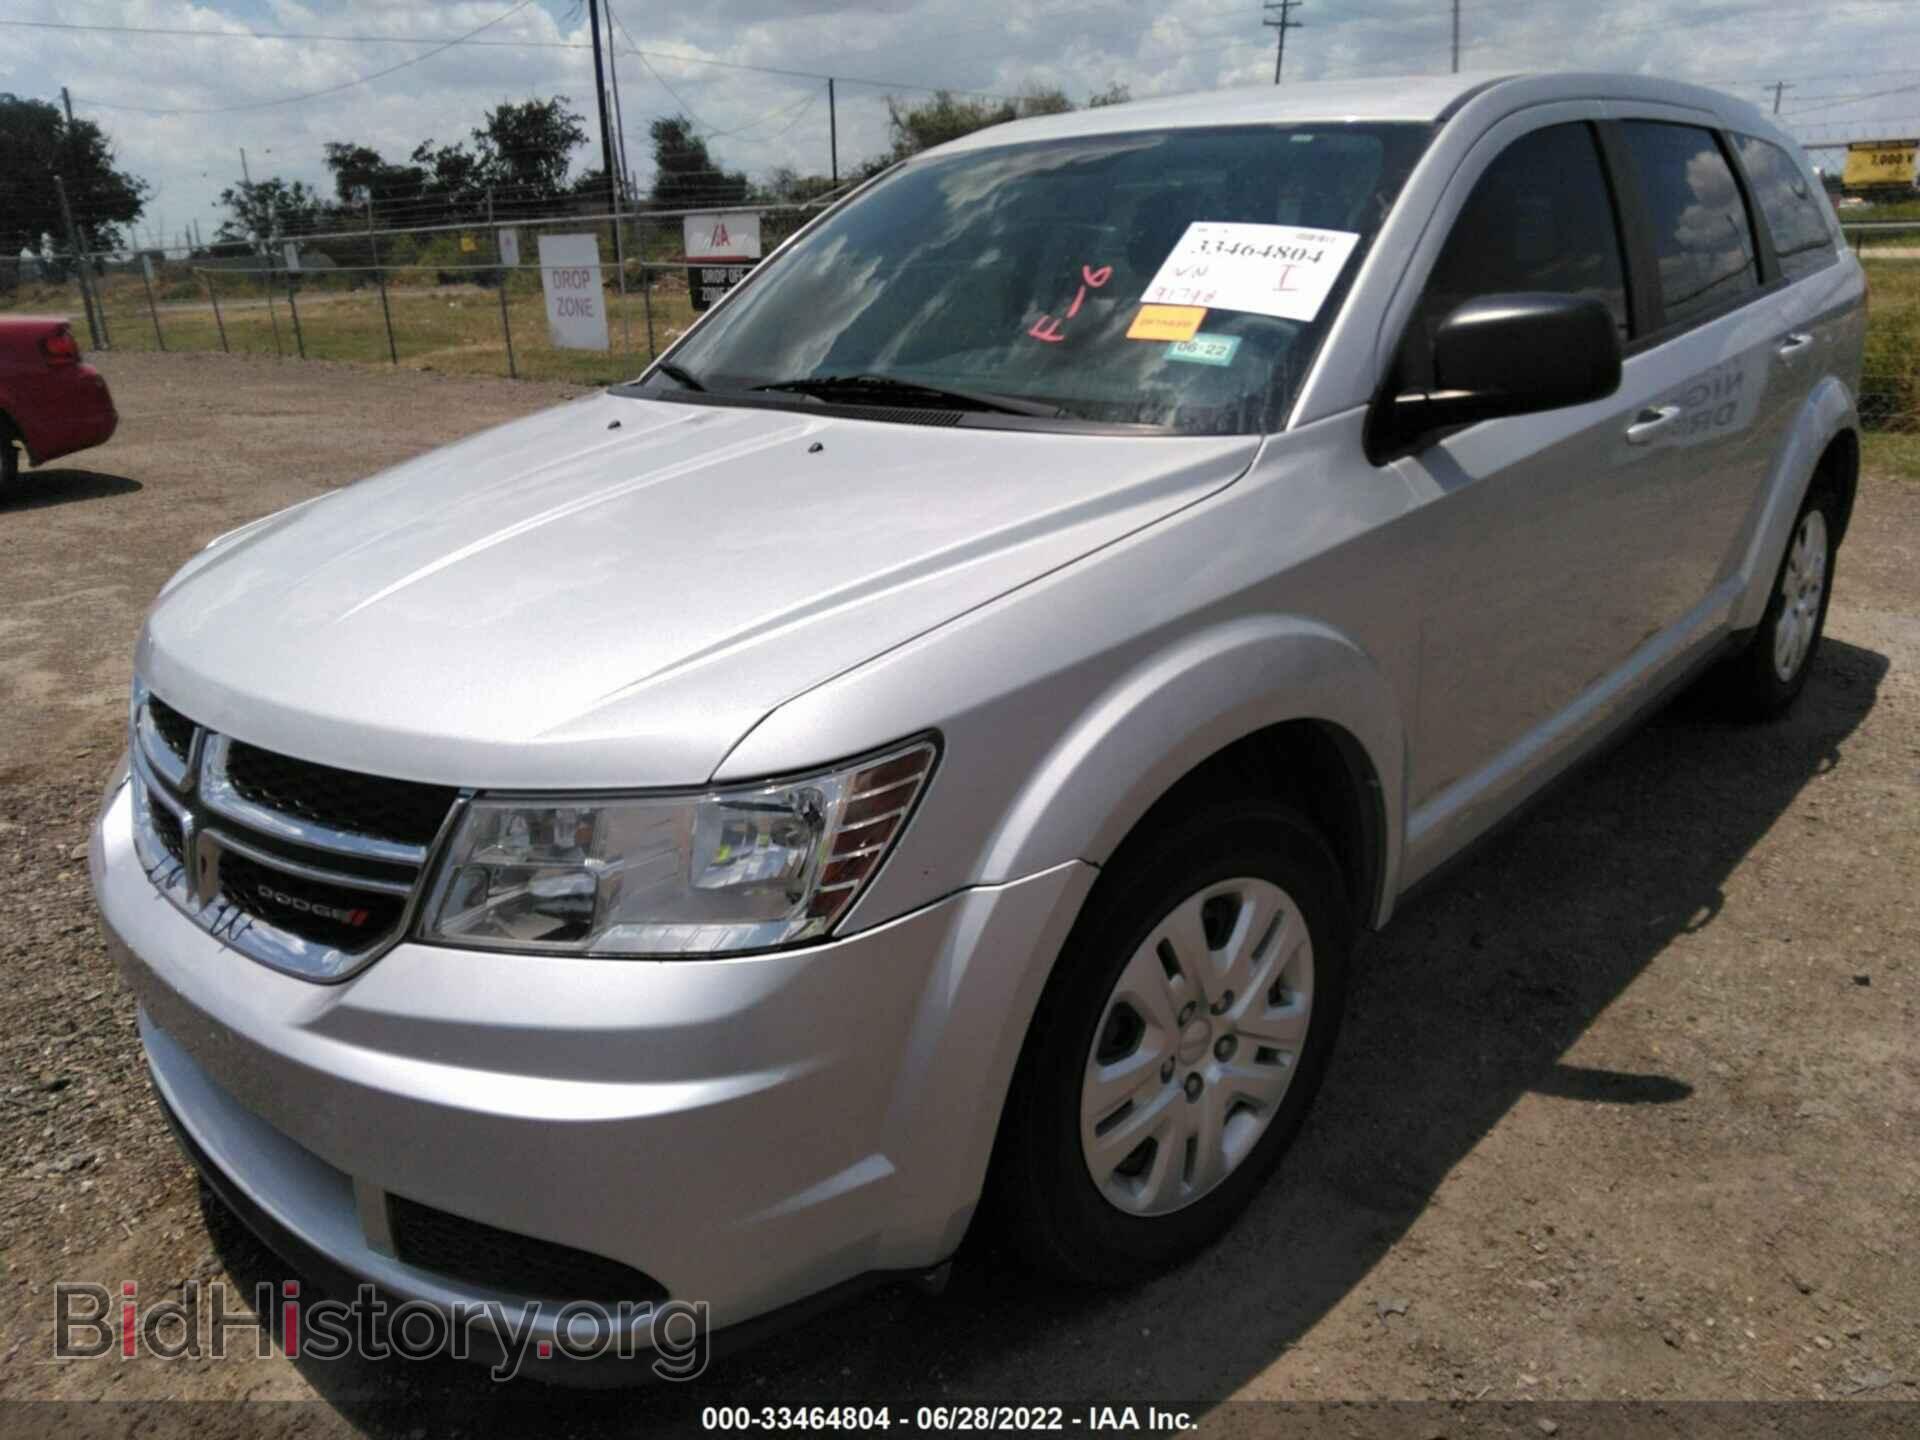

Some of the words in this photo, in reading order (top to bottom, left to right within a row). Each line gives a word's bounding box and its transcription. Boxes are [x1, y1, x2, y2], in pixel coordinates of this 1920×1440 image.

[1190, 239, 1325, 264] 33464804
[552, 269, 591, 290] DROP
[702, 268, 727, 284] DROP
[556, 296, 594, 319] ZONE
[257, 884, 351, 924] DODGE
